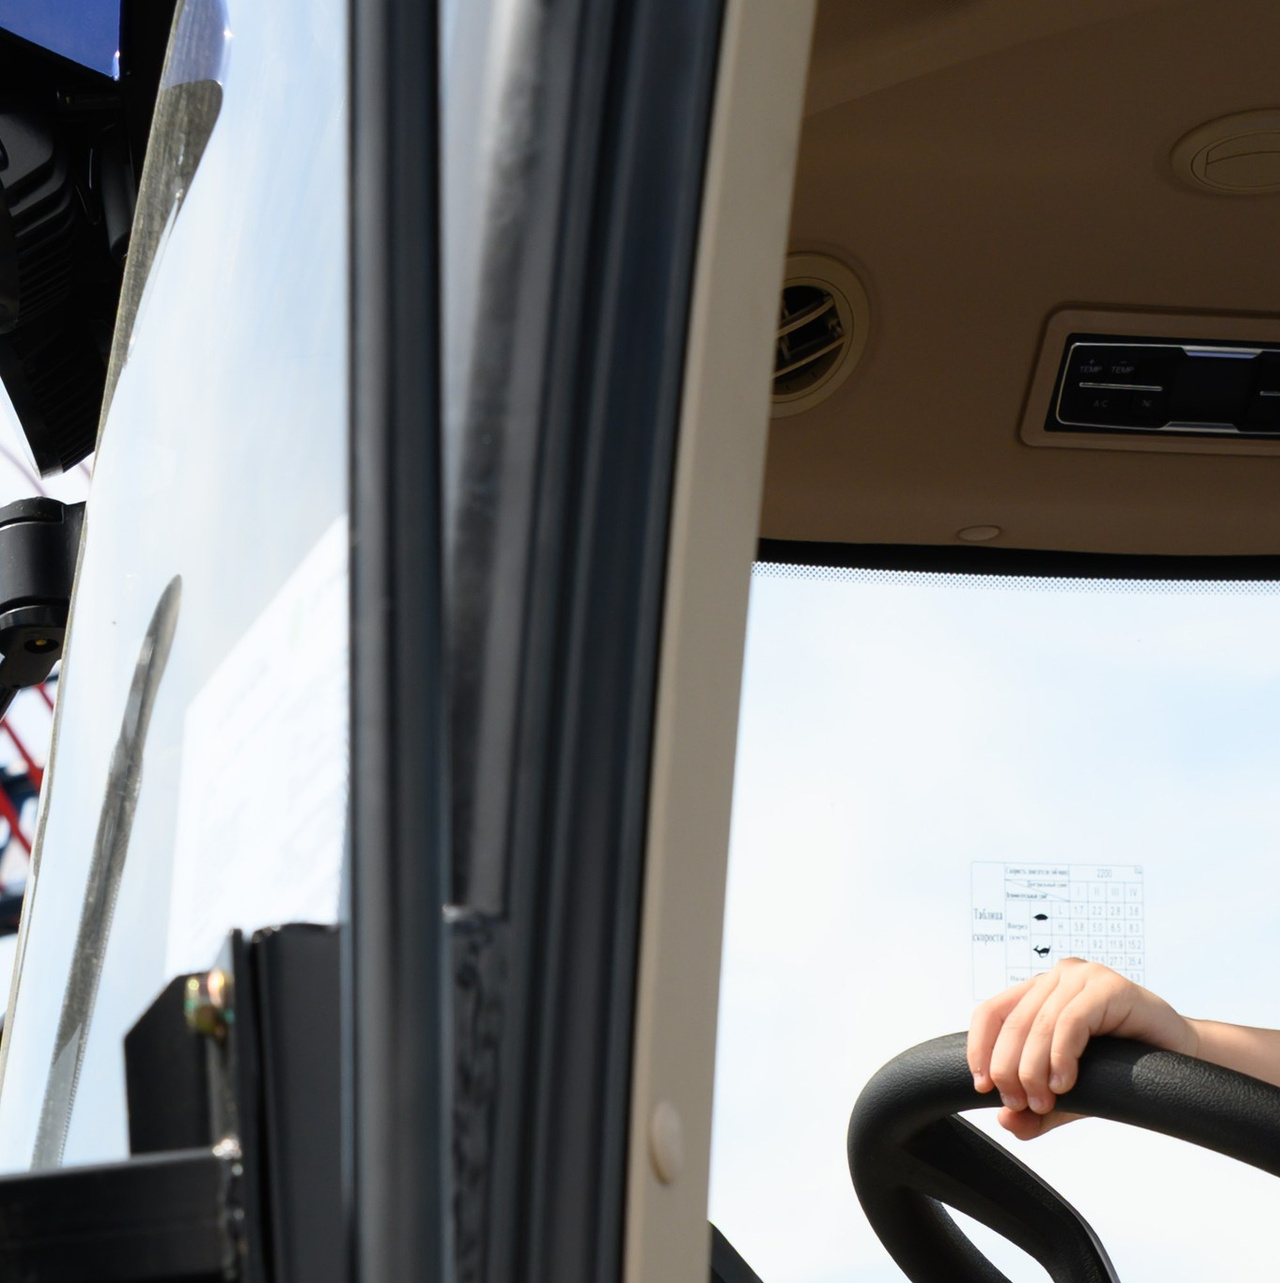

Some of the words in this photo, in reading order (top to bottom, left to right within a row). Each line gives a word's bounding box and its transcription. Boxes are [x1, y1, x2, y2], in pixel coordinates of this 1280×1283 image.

[1080, 365, 1103, 375] TEMP
[1111, 366, 1135, 376] TEMP
[973, 906, 1003, 921] Таблица
[971, 933, 1004, 946] скорости
